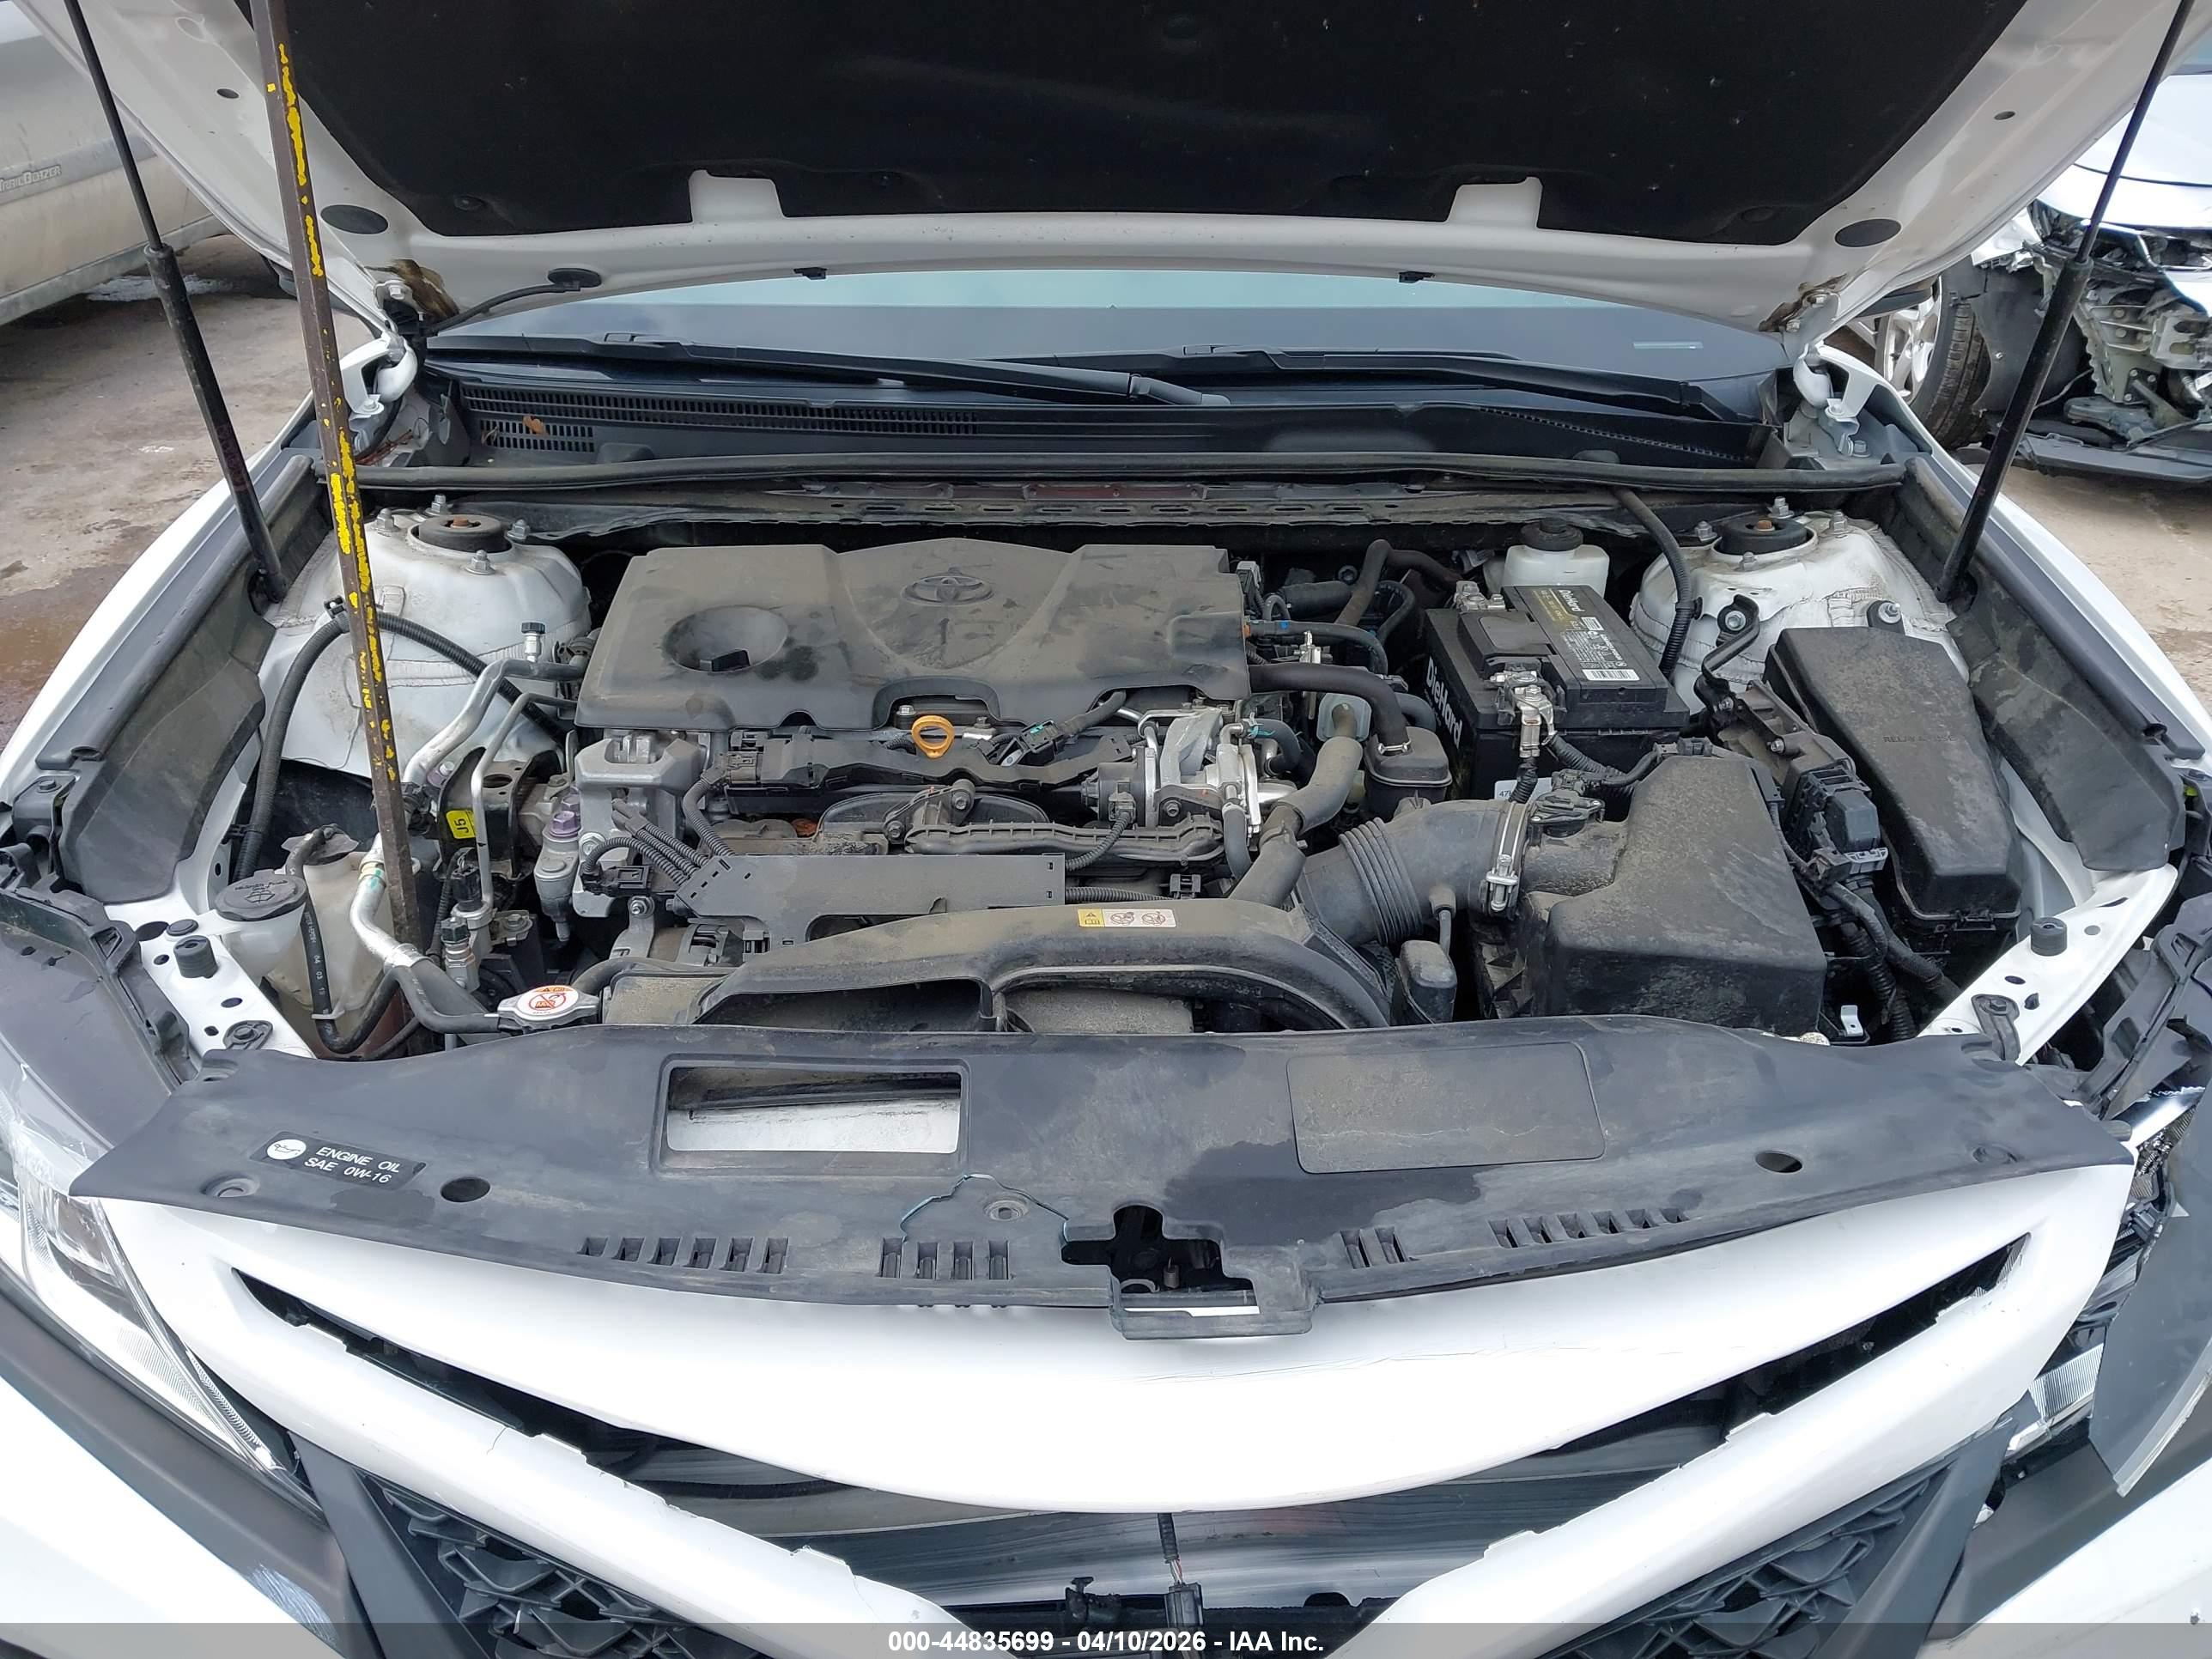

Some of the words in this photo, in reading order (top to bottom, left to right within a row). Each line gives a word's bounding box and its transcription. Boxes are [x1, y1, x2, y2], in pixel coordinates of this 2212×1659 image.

[1559, 589, 1585, 612] DieHard
[1426, 655, 1463, 750] DieHard
[454, 818, 470, 833] J5
[304, 1158, 338, 1171] SAE
[343, 1166, 392, 1184] 0W-16
[316, 1146, 373, 1166] ENGINE
[378, 1160, 401, 1173] OIL
